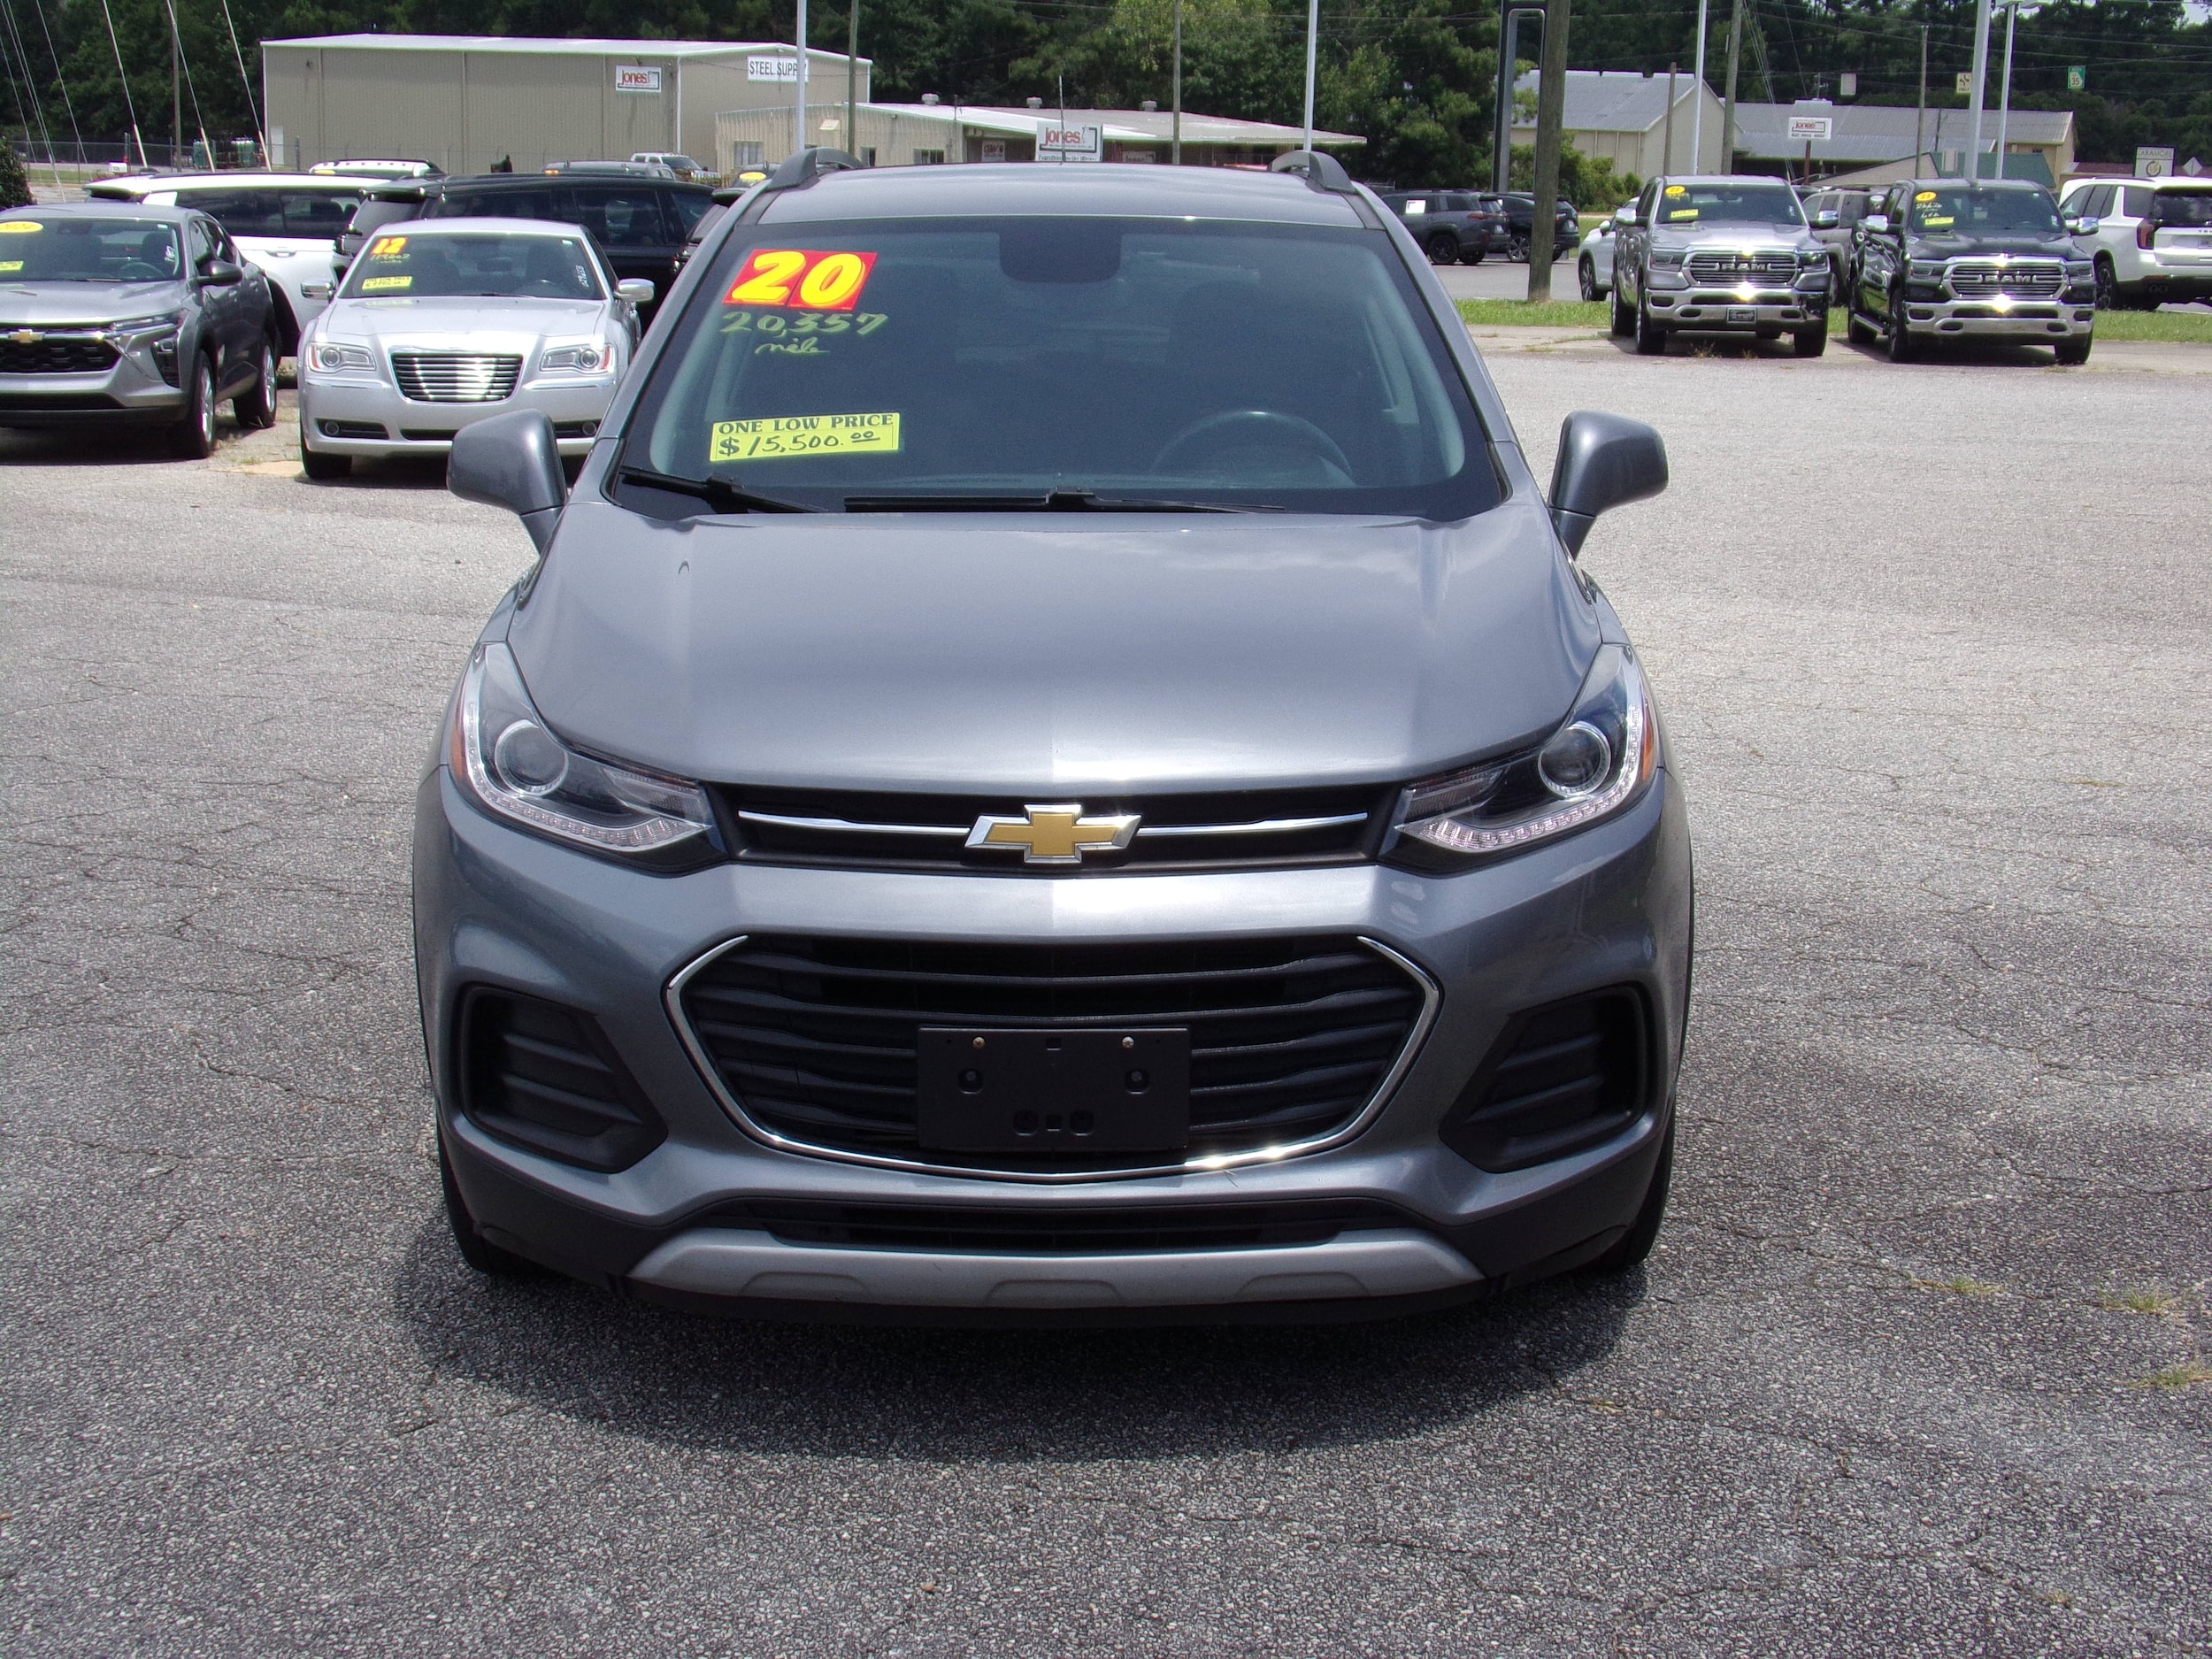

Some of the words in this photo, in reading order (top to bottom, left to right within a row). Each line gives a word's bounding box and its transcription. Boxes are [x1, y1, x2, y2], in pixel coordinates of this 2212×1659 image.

[749, 60, 774, 75] STEEL
[777, 62, 807, 77] SUPP
[2070, 77, 2080, 86] 35
[373, 237, 406, 254] 12
[731, 250, 866, 307] 20
[1984, 274, 2030, 283] RAM
[720, 311, 888, 338] 20,357
[718, 421, 763, 434] ONE
[773, 418, 819, 431] LOW
[831, 414, 894, 428] PRICE
